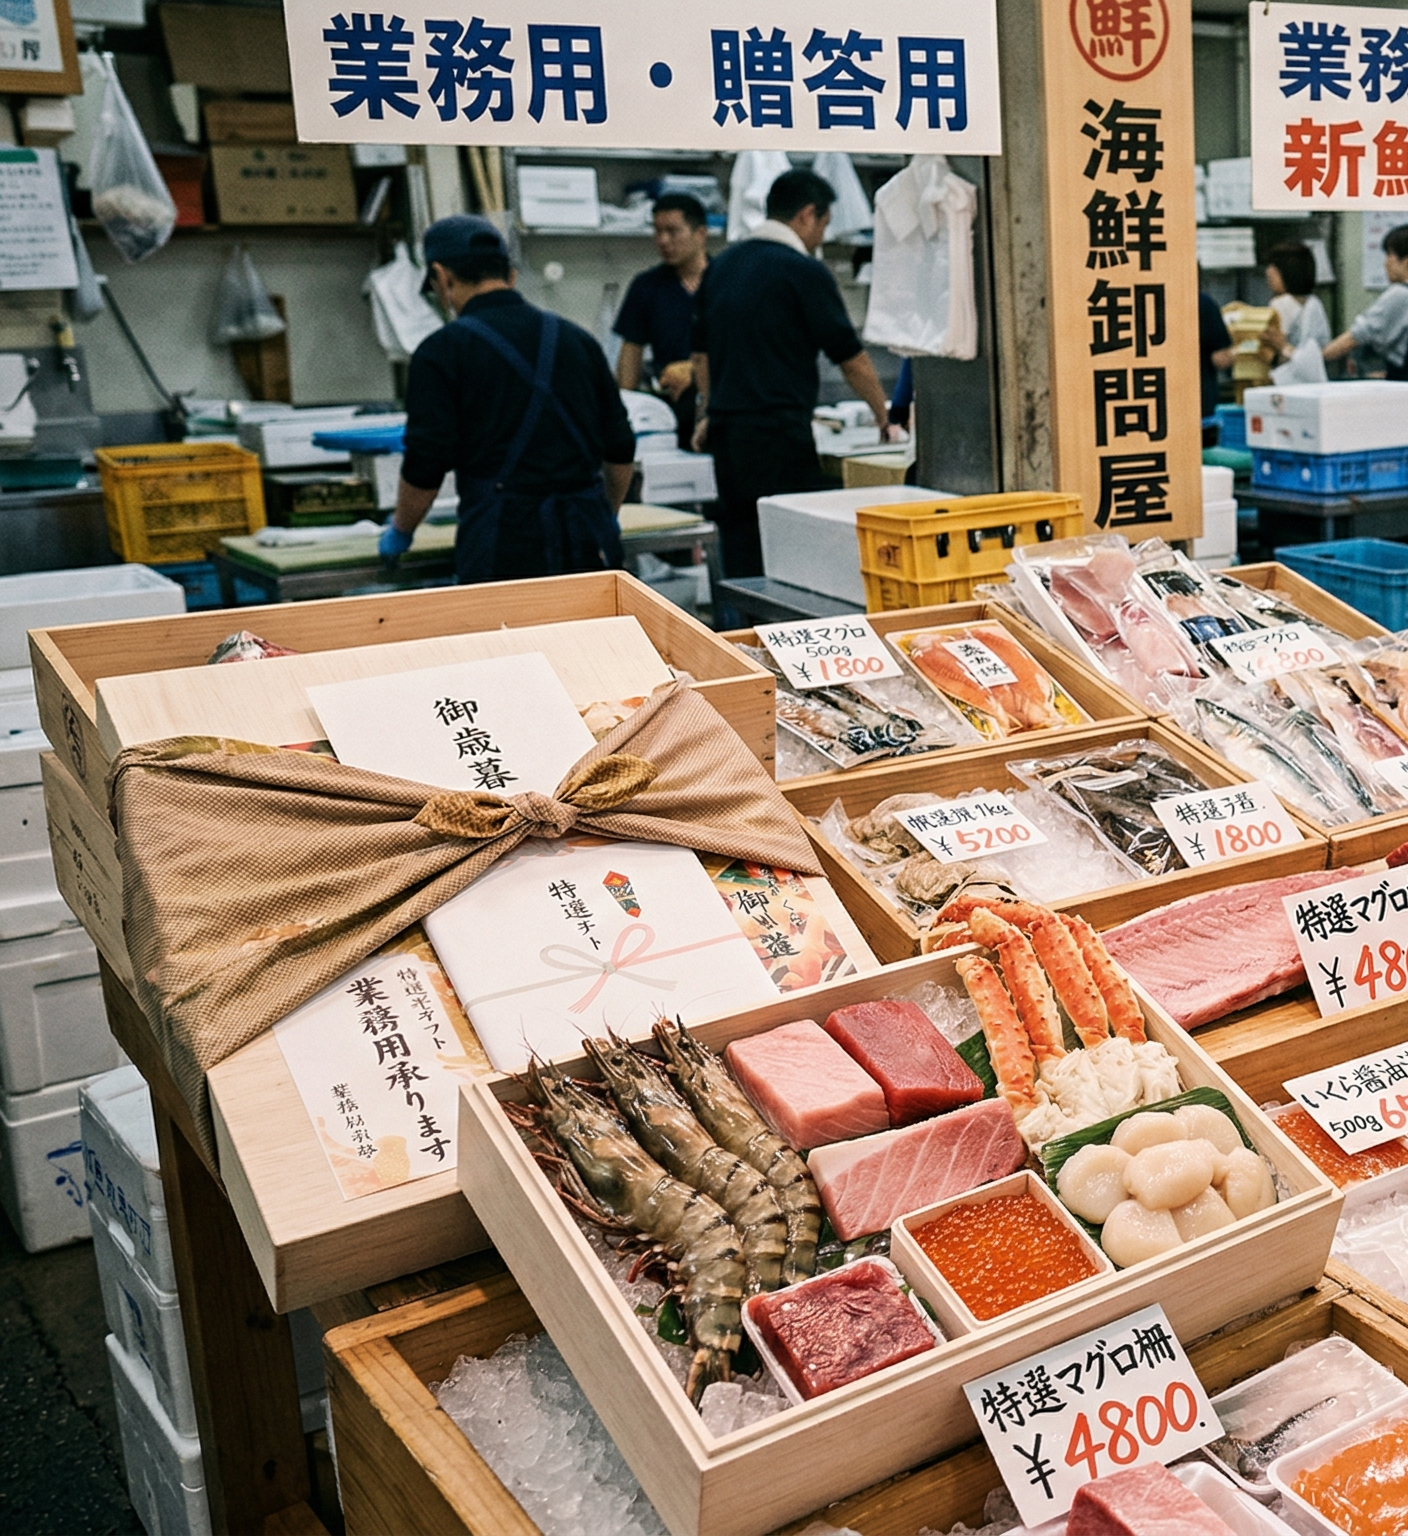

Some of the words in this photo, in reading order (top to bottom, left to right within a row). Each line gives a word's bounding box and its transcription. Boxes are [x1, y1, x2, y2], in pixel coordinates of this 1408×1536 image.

[322, 13, 969, 132] 業務用・贈答用
[1080, 98, 1173, 530] 海鮮卸問屋
[433, 697, 519, 790] 御歳暮
[981, 1323, 1177, 1433] 特選マグロ柵
